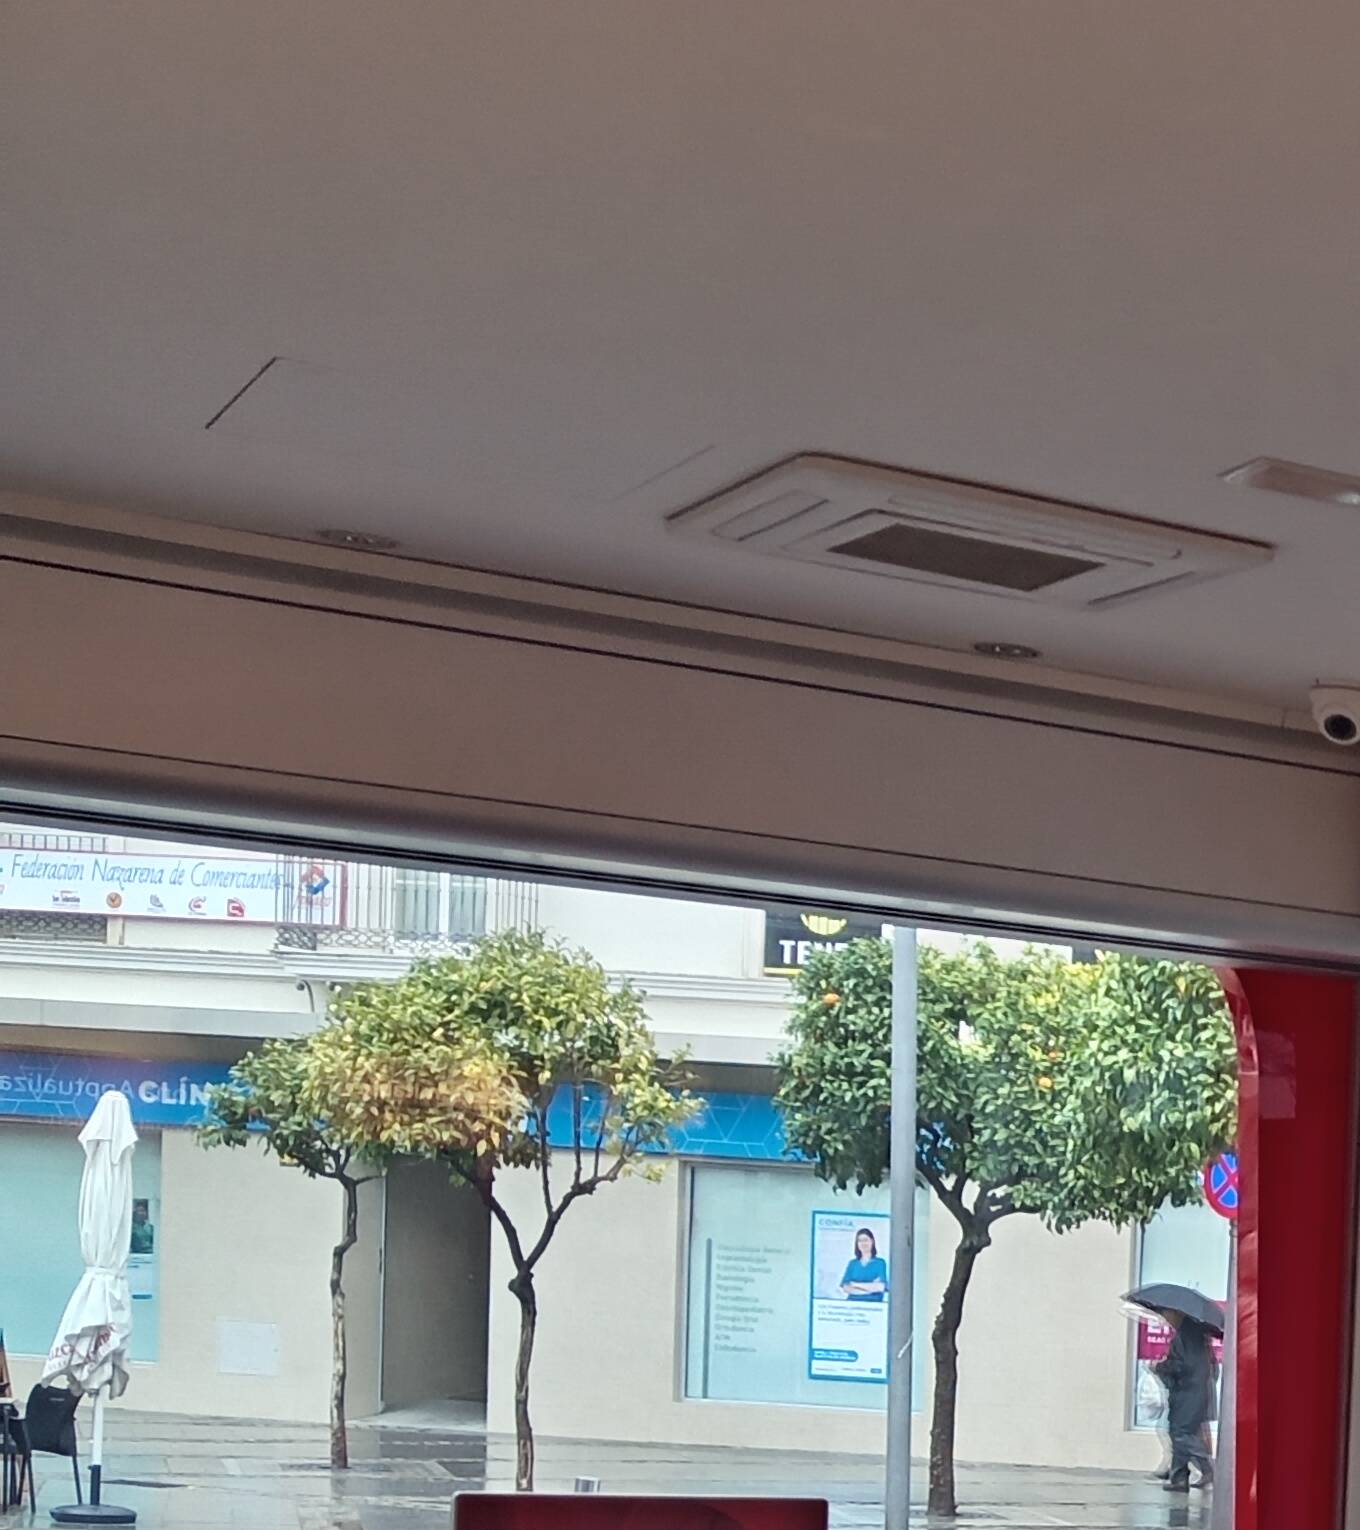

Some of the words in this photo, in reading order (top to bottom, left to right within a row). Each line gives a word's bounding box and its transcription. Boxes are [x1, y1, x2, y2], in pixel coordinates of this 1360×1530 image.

[11, 853, 84, 881] Federación
[91, 858, 164, 890] Nazarena
[169, 860, 184, 886] de
